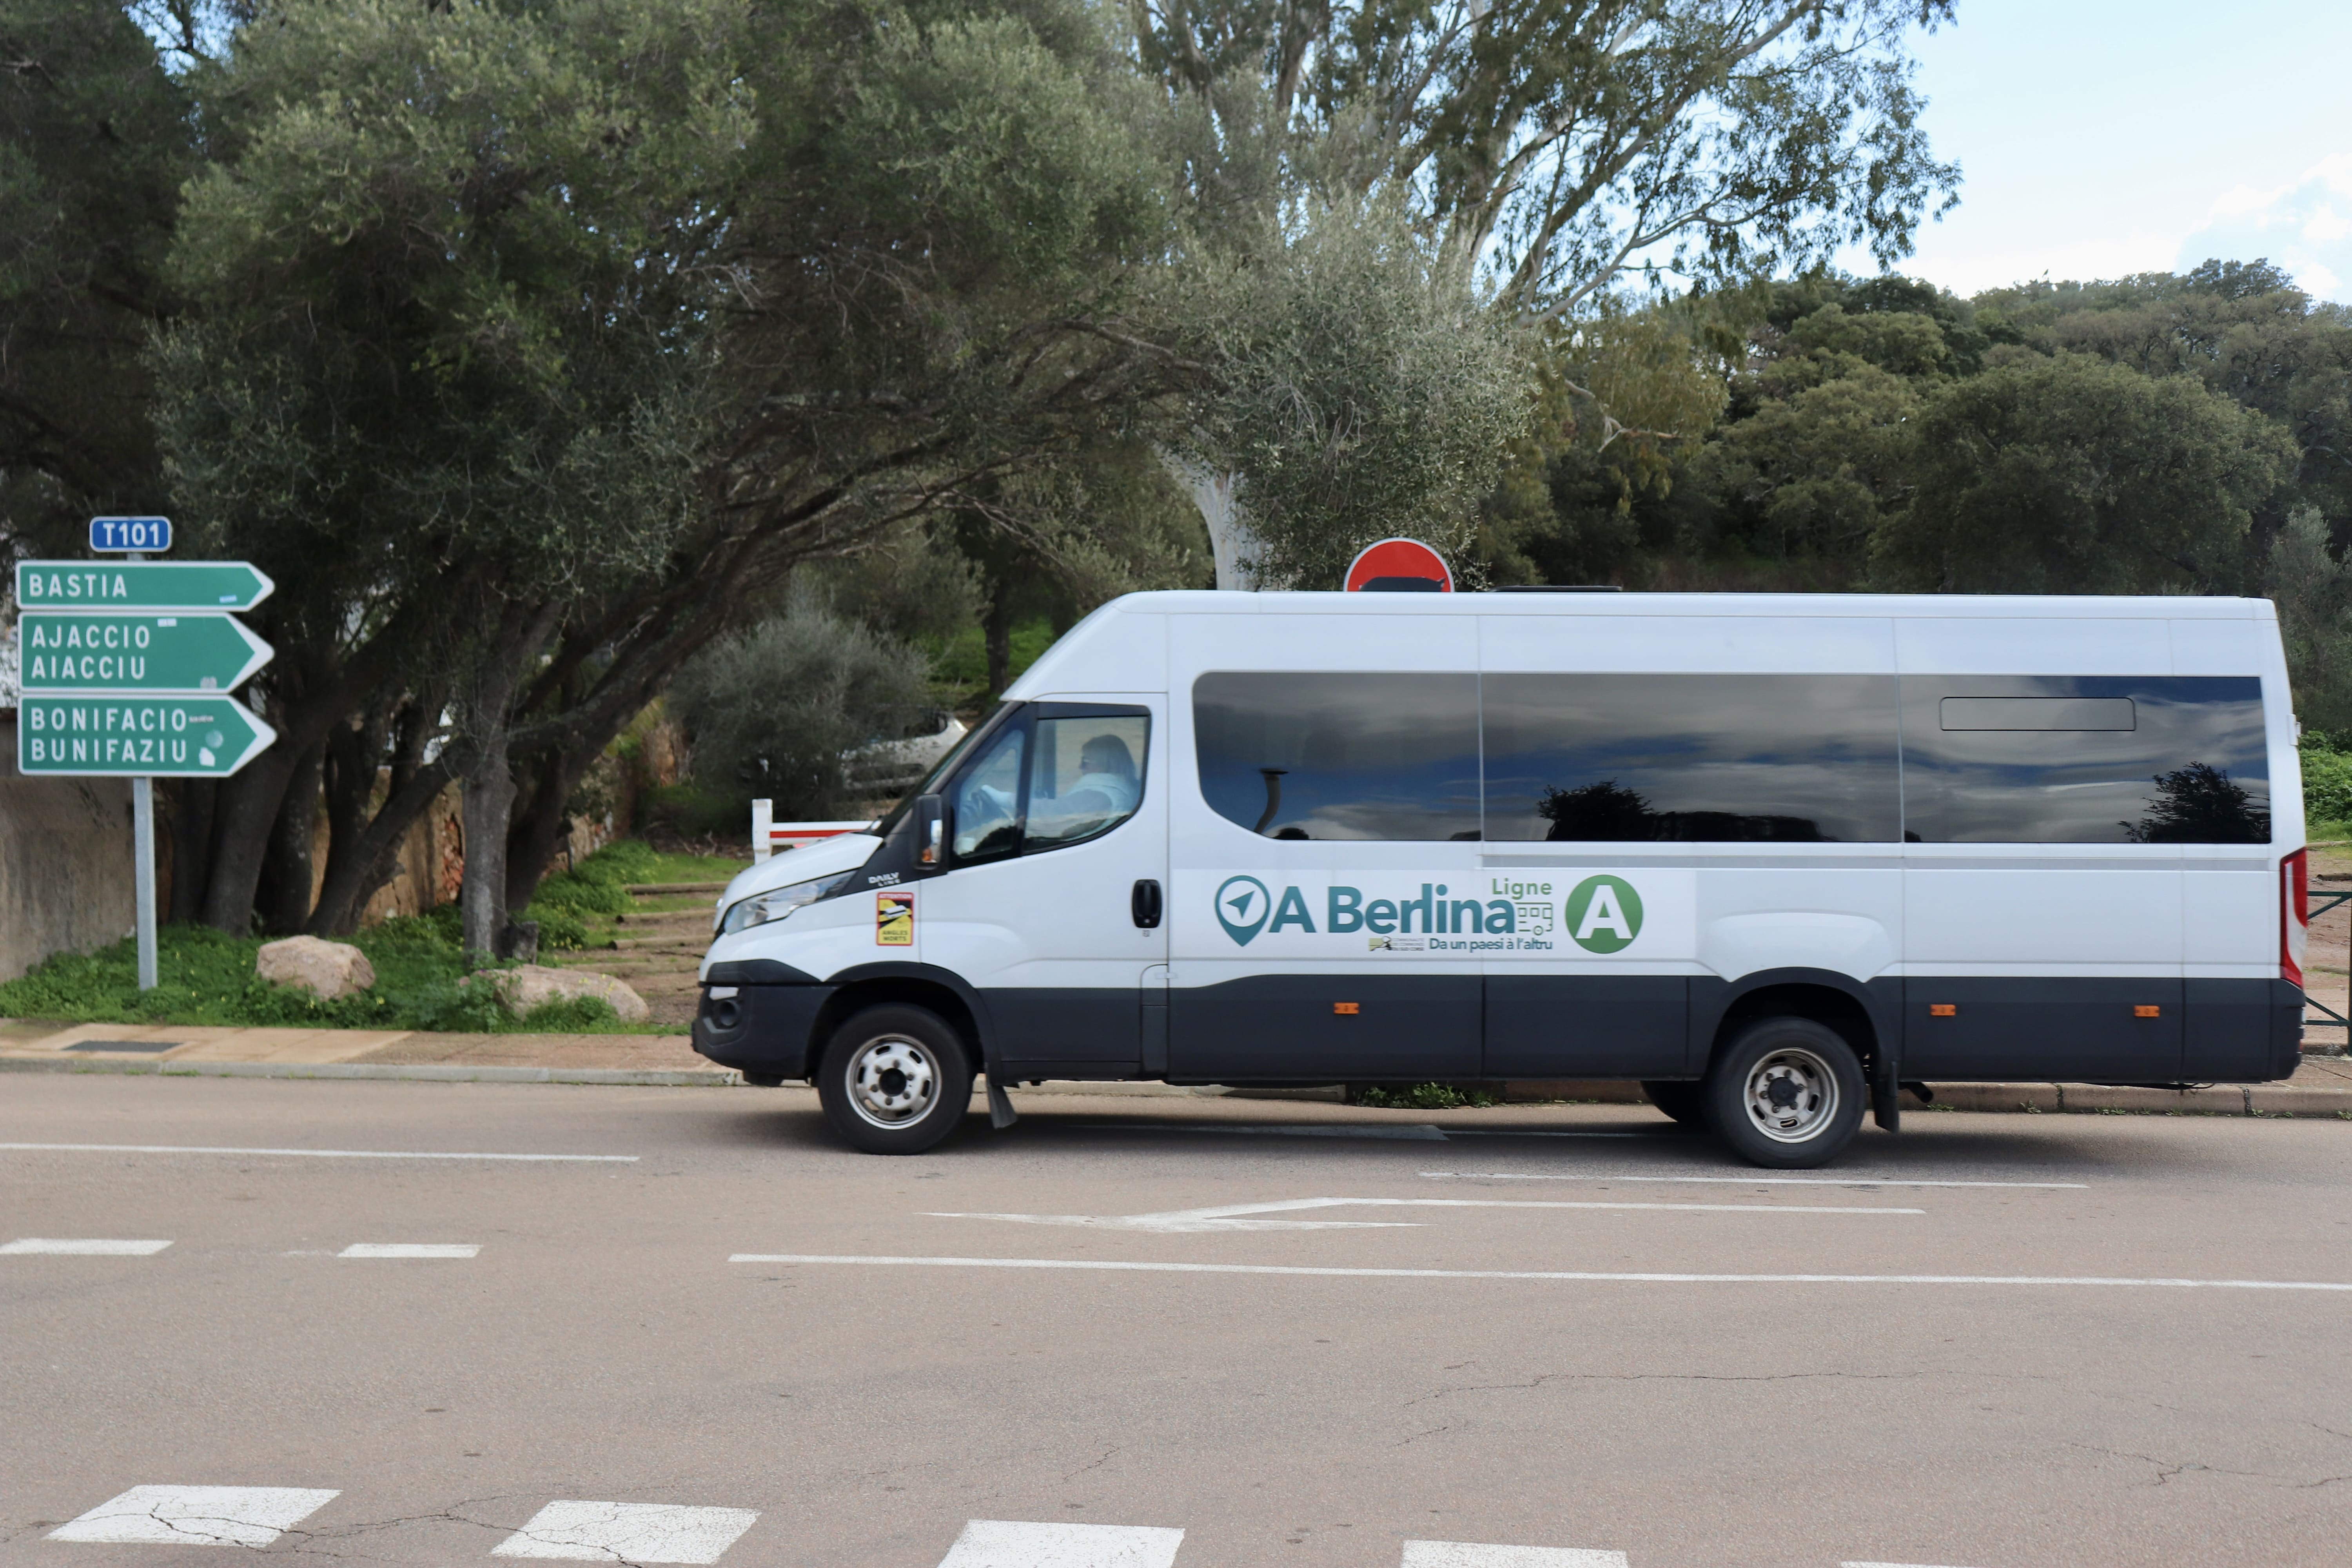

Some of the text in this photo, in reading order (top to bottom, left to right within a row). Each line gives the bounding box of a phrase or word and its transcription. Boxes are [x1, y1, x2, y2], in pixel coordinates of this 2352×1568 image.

[103, 523, 159, 546] T101
[29, 574, 127, 597] BASTIA
[31, 625, 150, 649] AJACCIO
[31, 655, 145, 680] AIACCIU
[31, 708, 187, 731] BONIFACIO
[31, 739, 187, 763] BUNIFAZIU
[868, 872, 899, 884] DAILY
[1492, 878, 1552, 900] Ligne
[1269, 883, 1515, 935] A Berlina
[1575, 884, 1634, 939] A
[1429, 938, 1447, 950] Da
[1450, 941, 1467, 950] un
[1470, 938, 1504, 953] paesi
[1506, 938, 1514, 950] à
